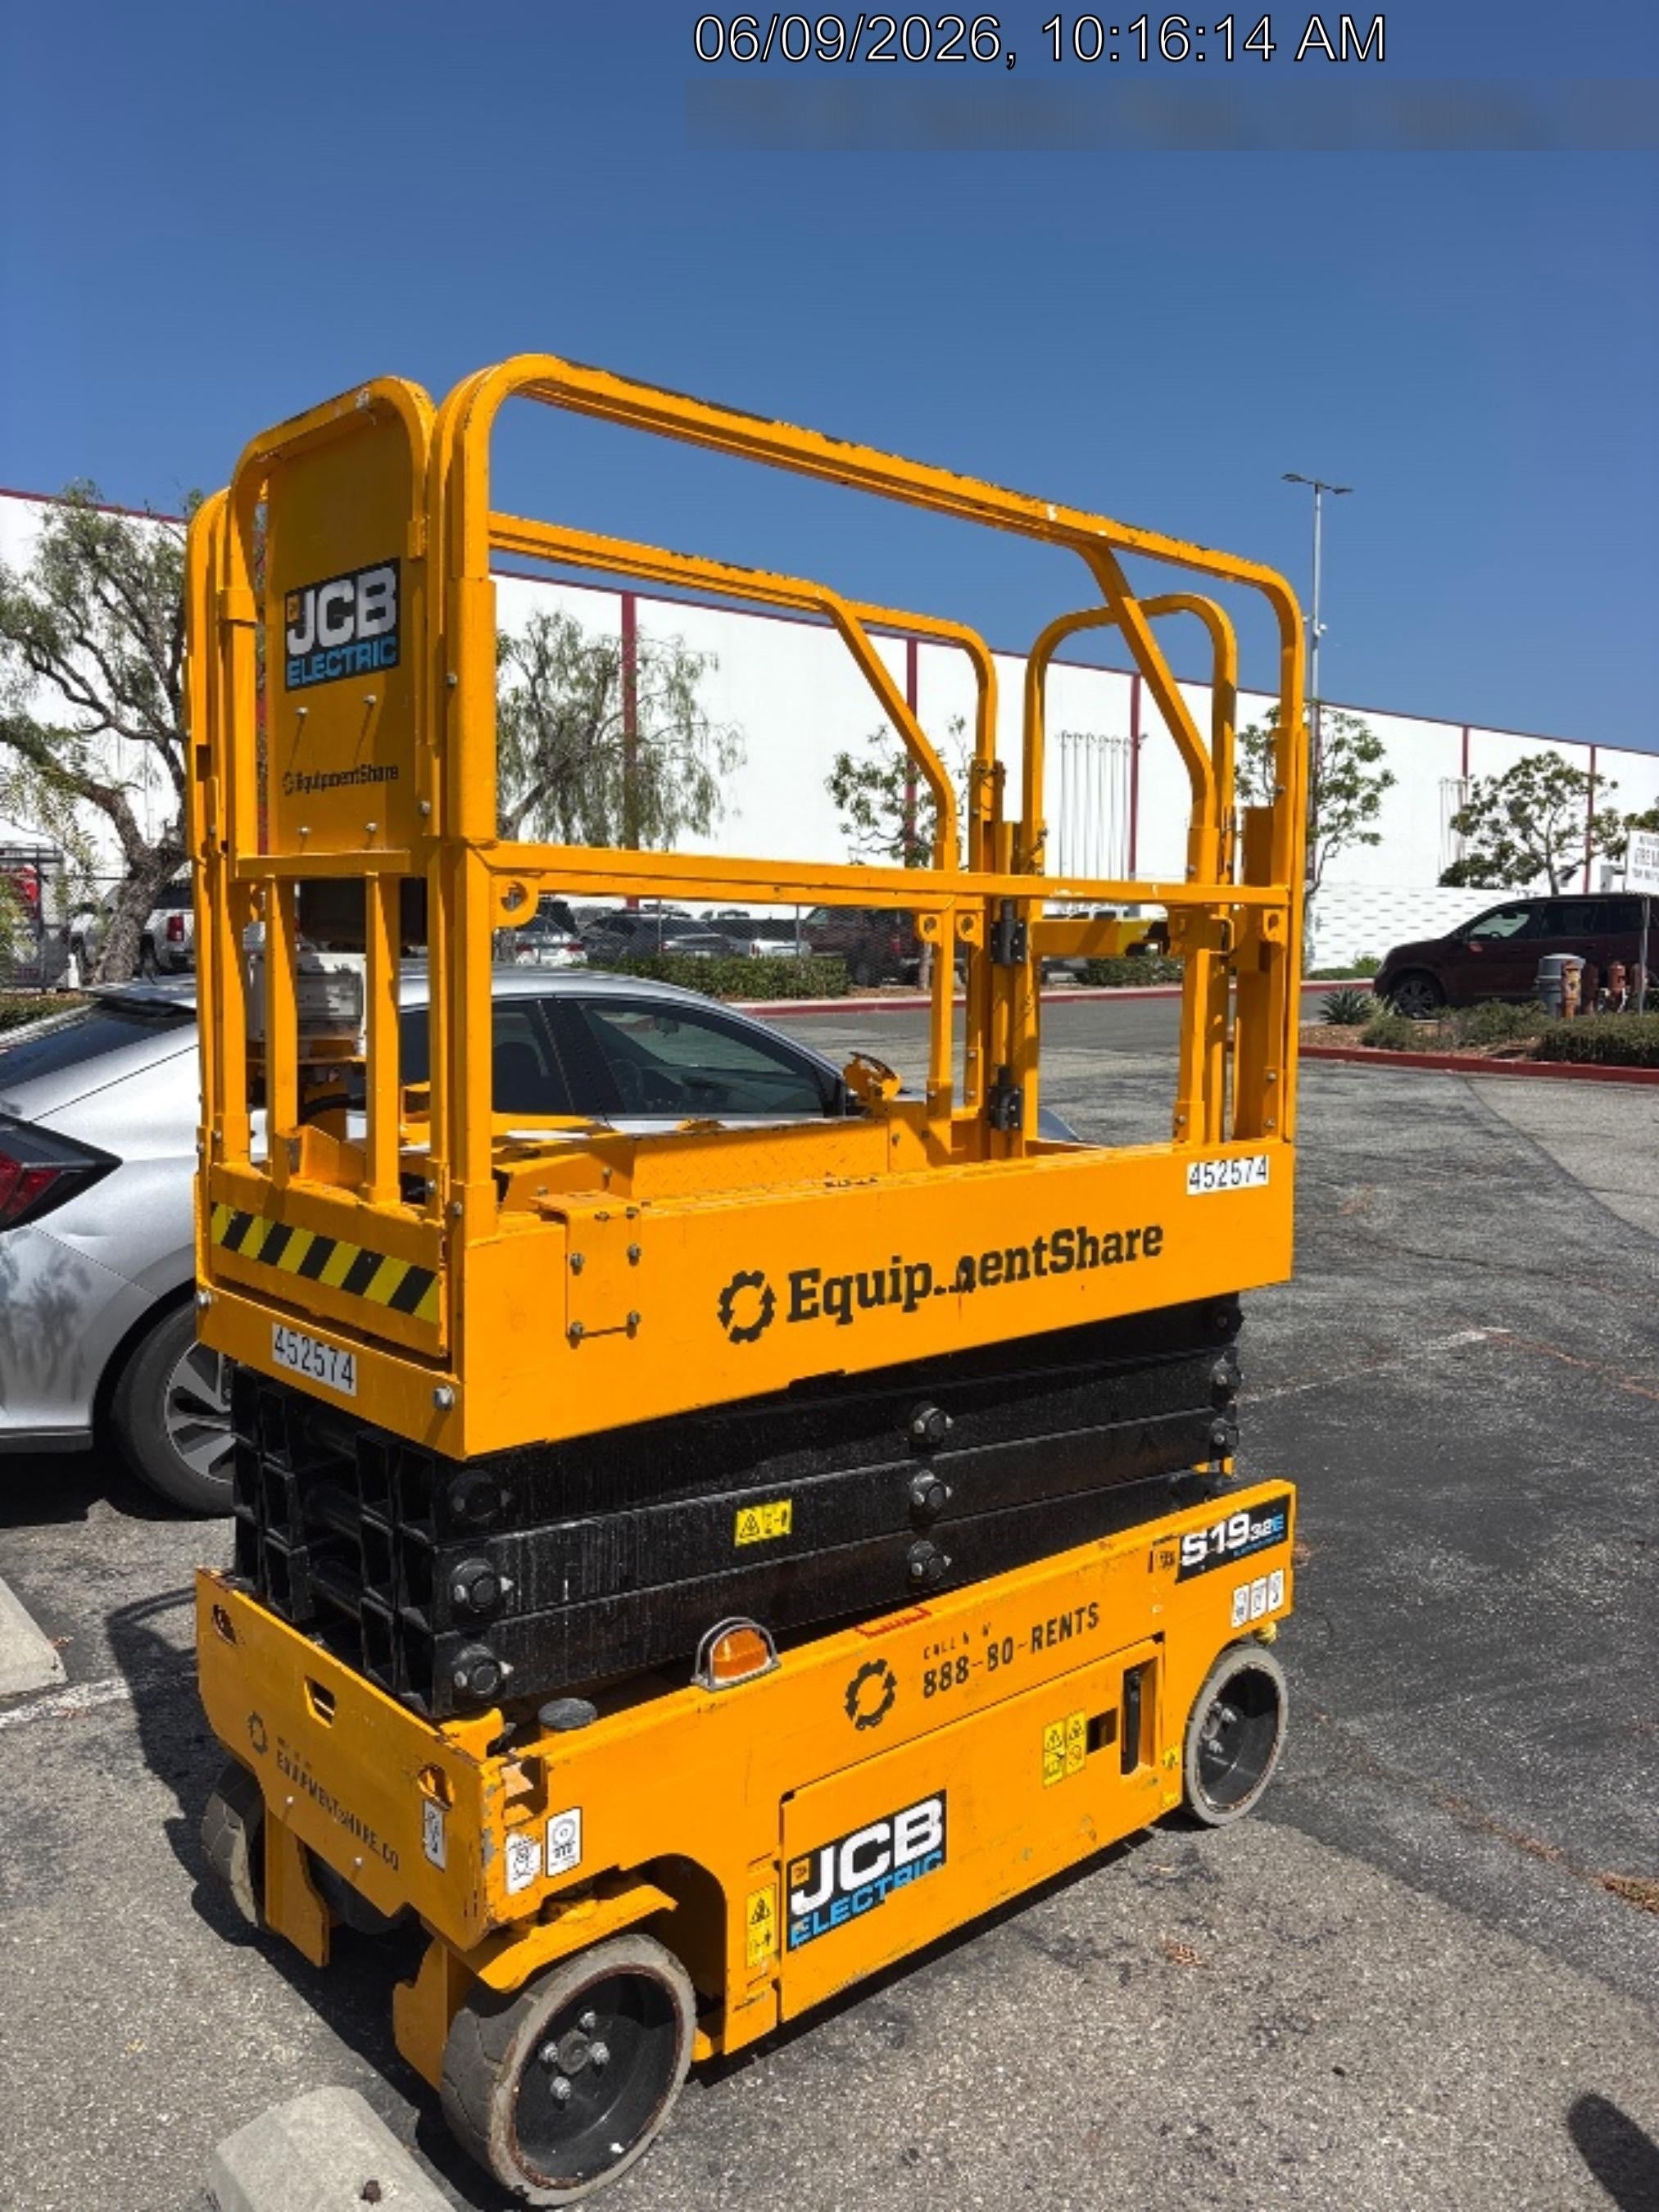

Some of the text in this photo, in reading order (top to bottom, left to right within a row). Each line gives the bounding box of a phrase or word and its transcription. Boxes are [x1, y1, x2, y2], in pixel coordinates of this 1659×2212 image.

[287, 567, 397, 656] JCB
[287, 635, 397, 686] ELECTRIC
[1189, 1155, 1267, 1190] 452574
[274, 1326, 354, 1389] 452574
[923, 1602, 1099, 1699] 888-80-RENTS
[791, 1798, 942, 1915] JCB
[791, 1850, 942, 1947] ELECTRIC
